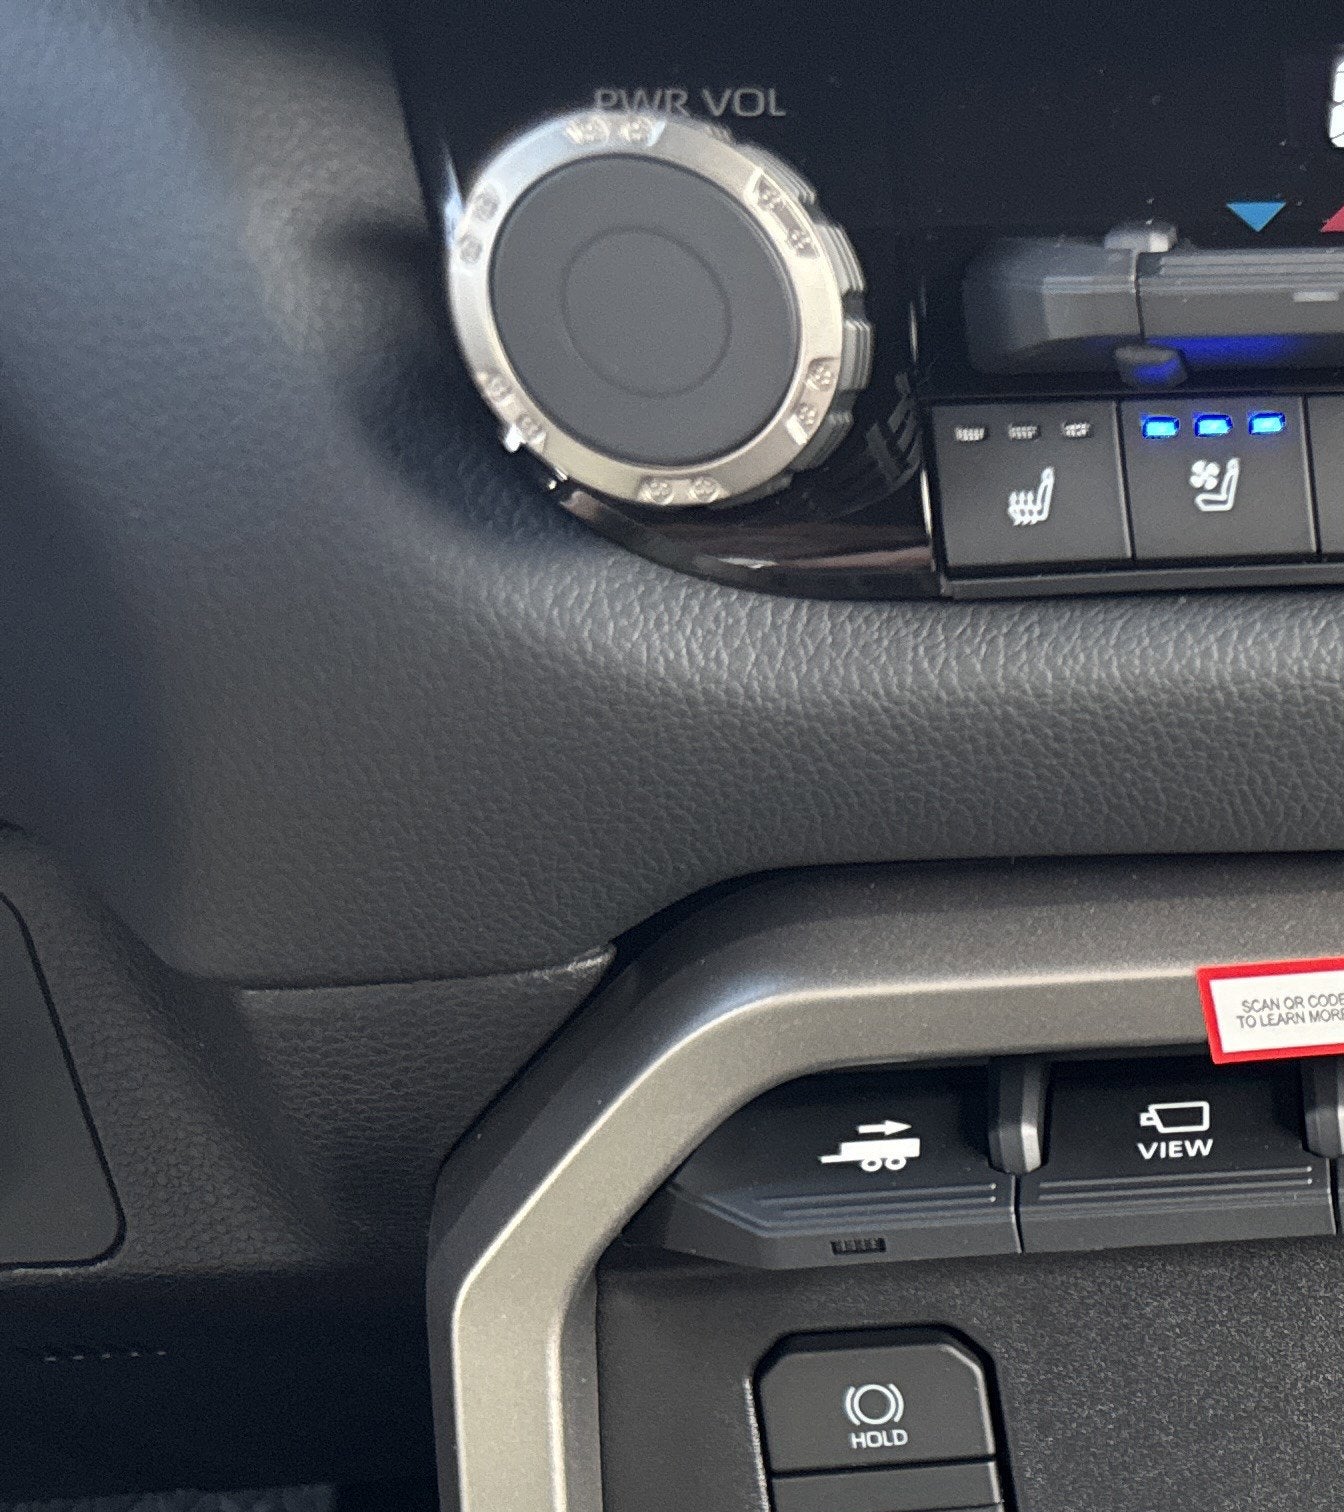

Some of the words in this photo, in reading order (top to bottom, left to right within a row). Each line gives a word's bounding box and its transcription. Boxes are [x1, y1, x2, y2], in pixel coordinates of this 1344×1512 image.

[594, 88, 689, 117] PWR
[701, 88, 786, 117] VOL
[1241, 998, 1280, 1013] SCAN
[1236, 1014, 1257, 1028] TO
[1259, 1011, 1305, 1026] LEARN
[1136, 1137, 1213, 1161] VIEW
[850, 1430, 908, 1448] HOLD
